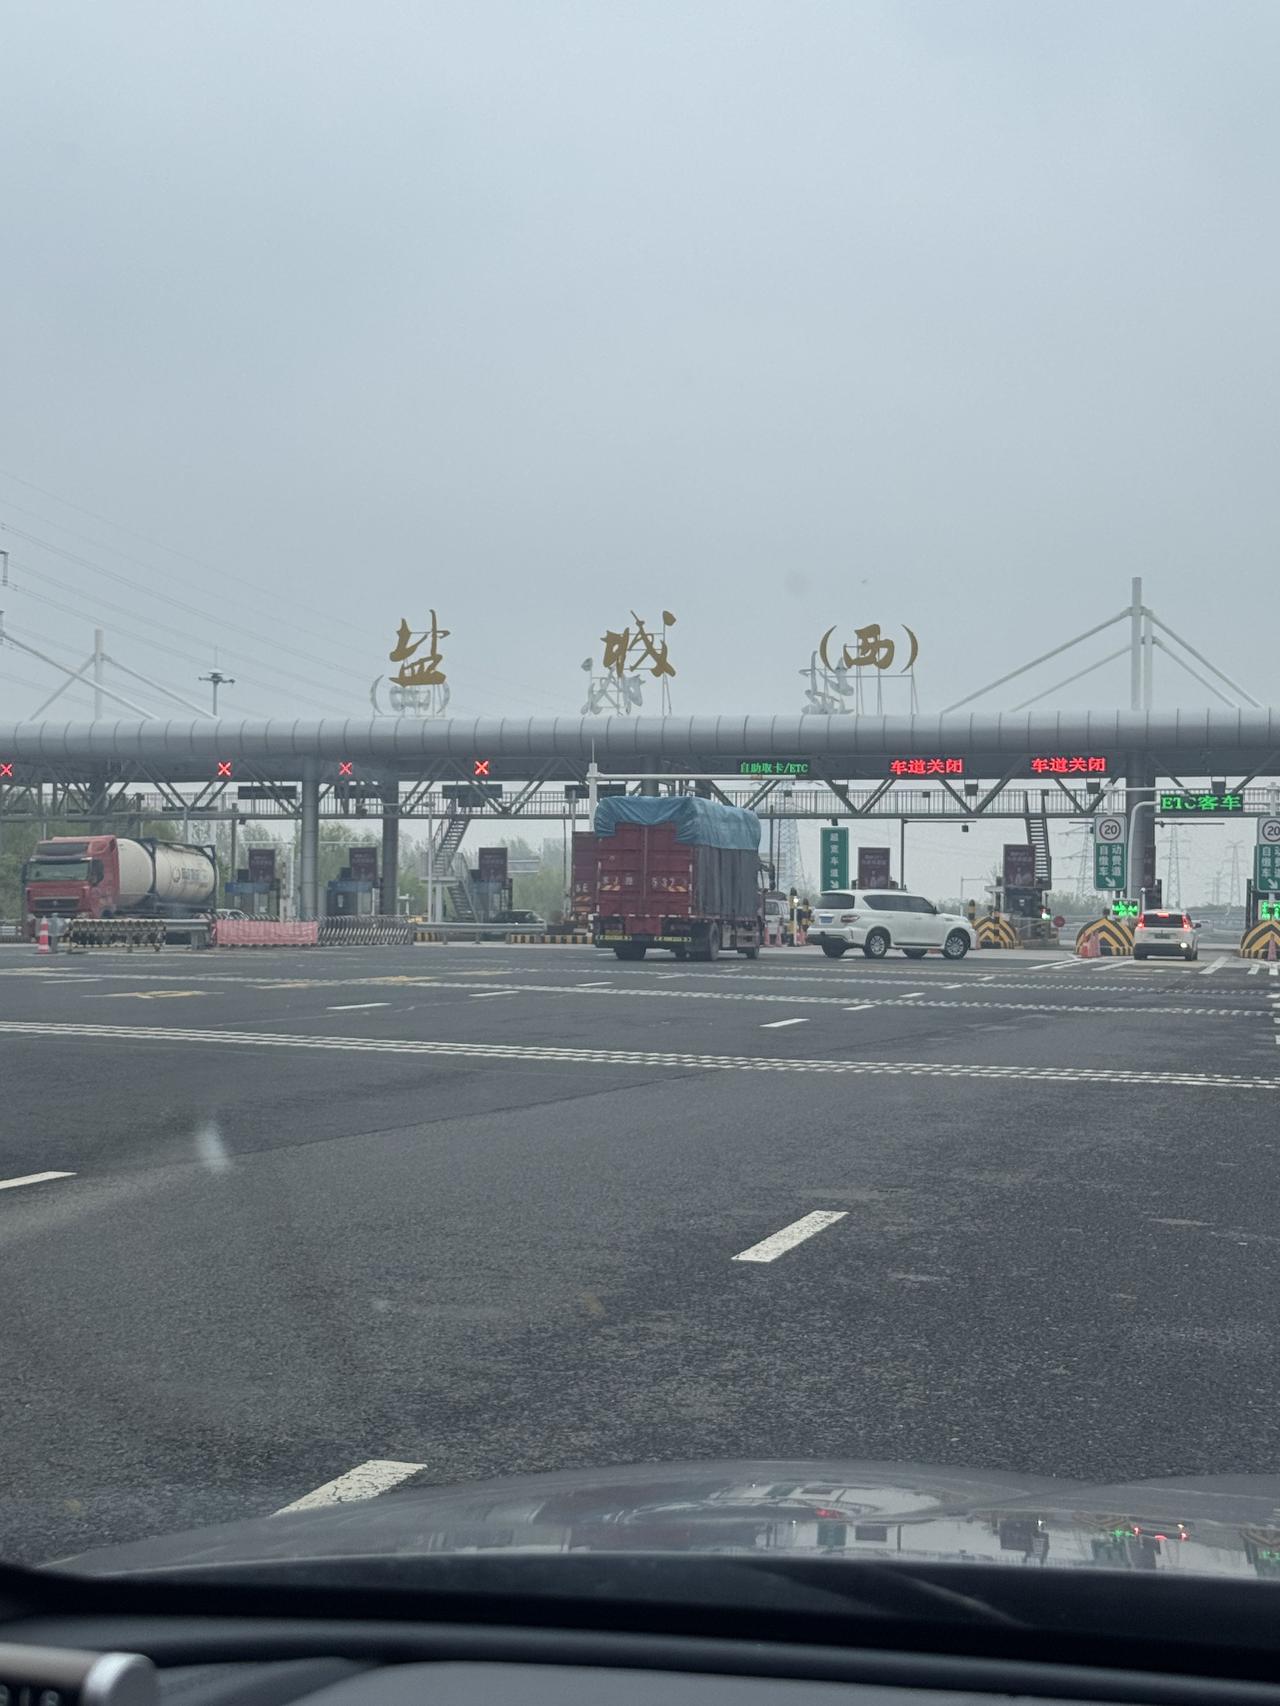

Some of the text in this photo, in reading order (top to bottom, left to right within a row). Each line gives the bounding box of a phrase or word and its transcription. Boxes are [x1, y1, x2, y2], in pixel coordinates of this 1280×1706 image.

[740, 762, 808, 774] 自助取卡/ETC
[890, 759, 963, 775] 车道关闭
[1031, 757, 1106, 773] 车道关闭
[1161, 795, 1241, 811] ETC客车
[1104, 825, 1118, 835] 20
